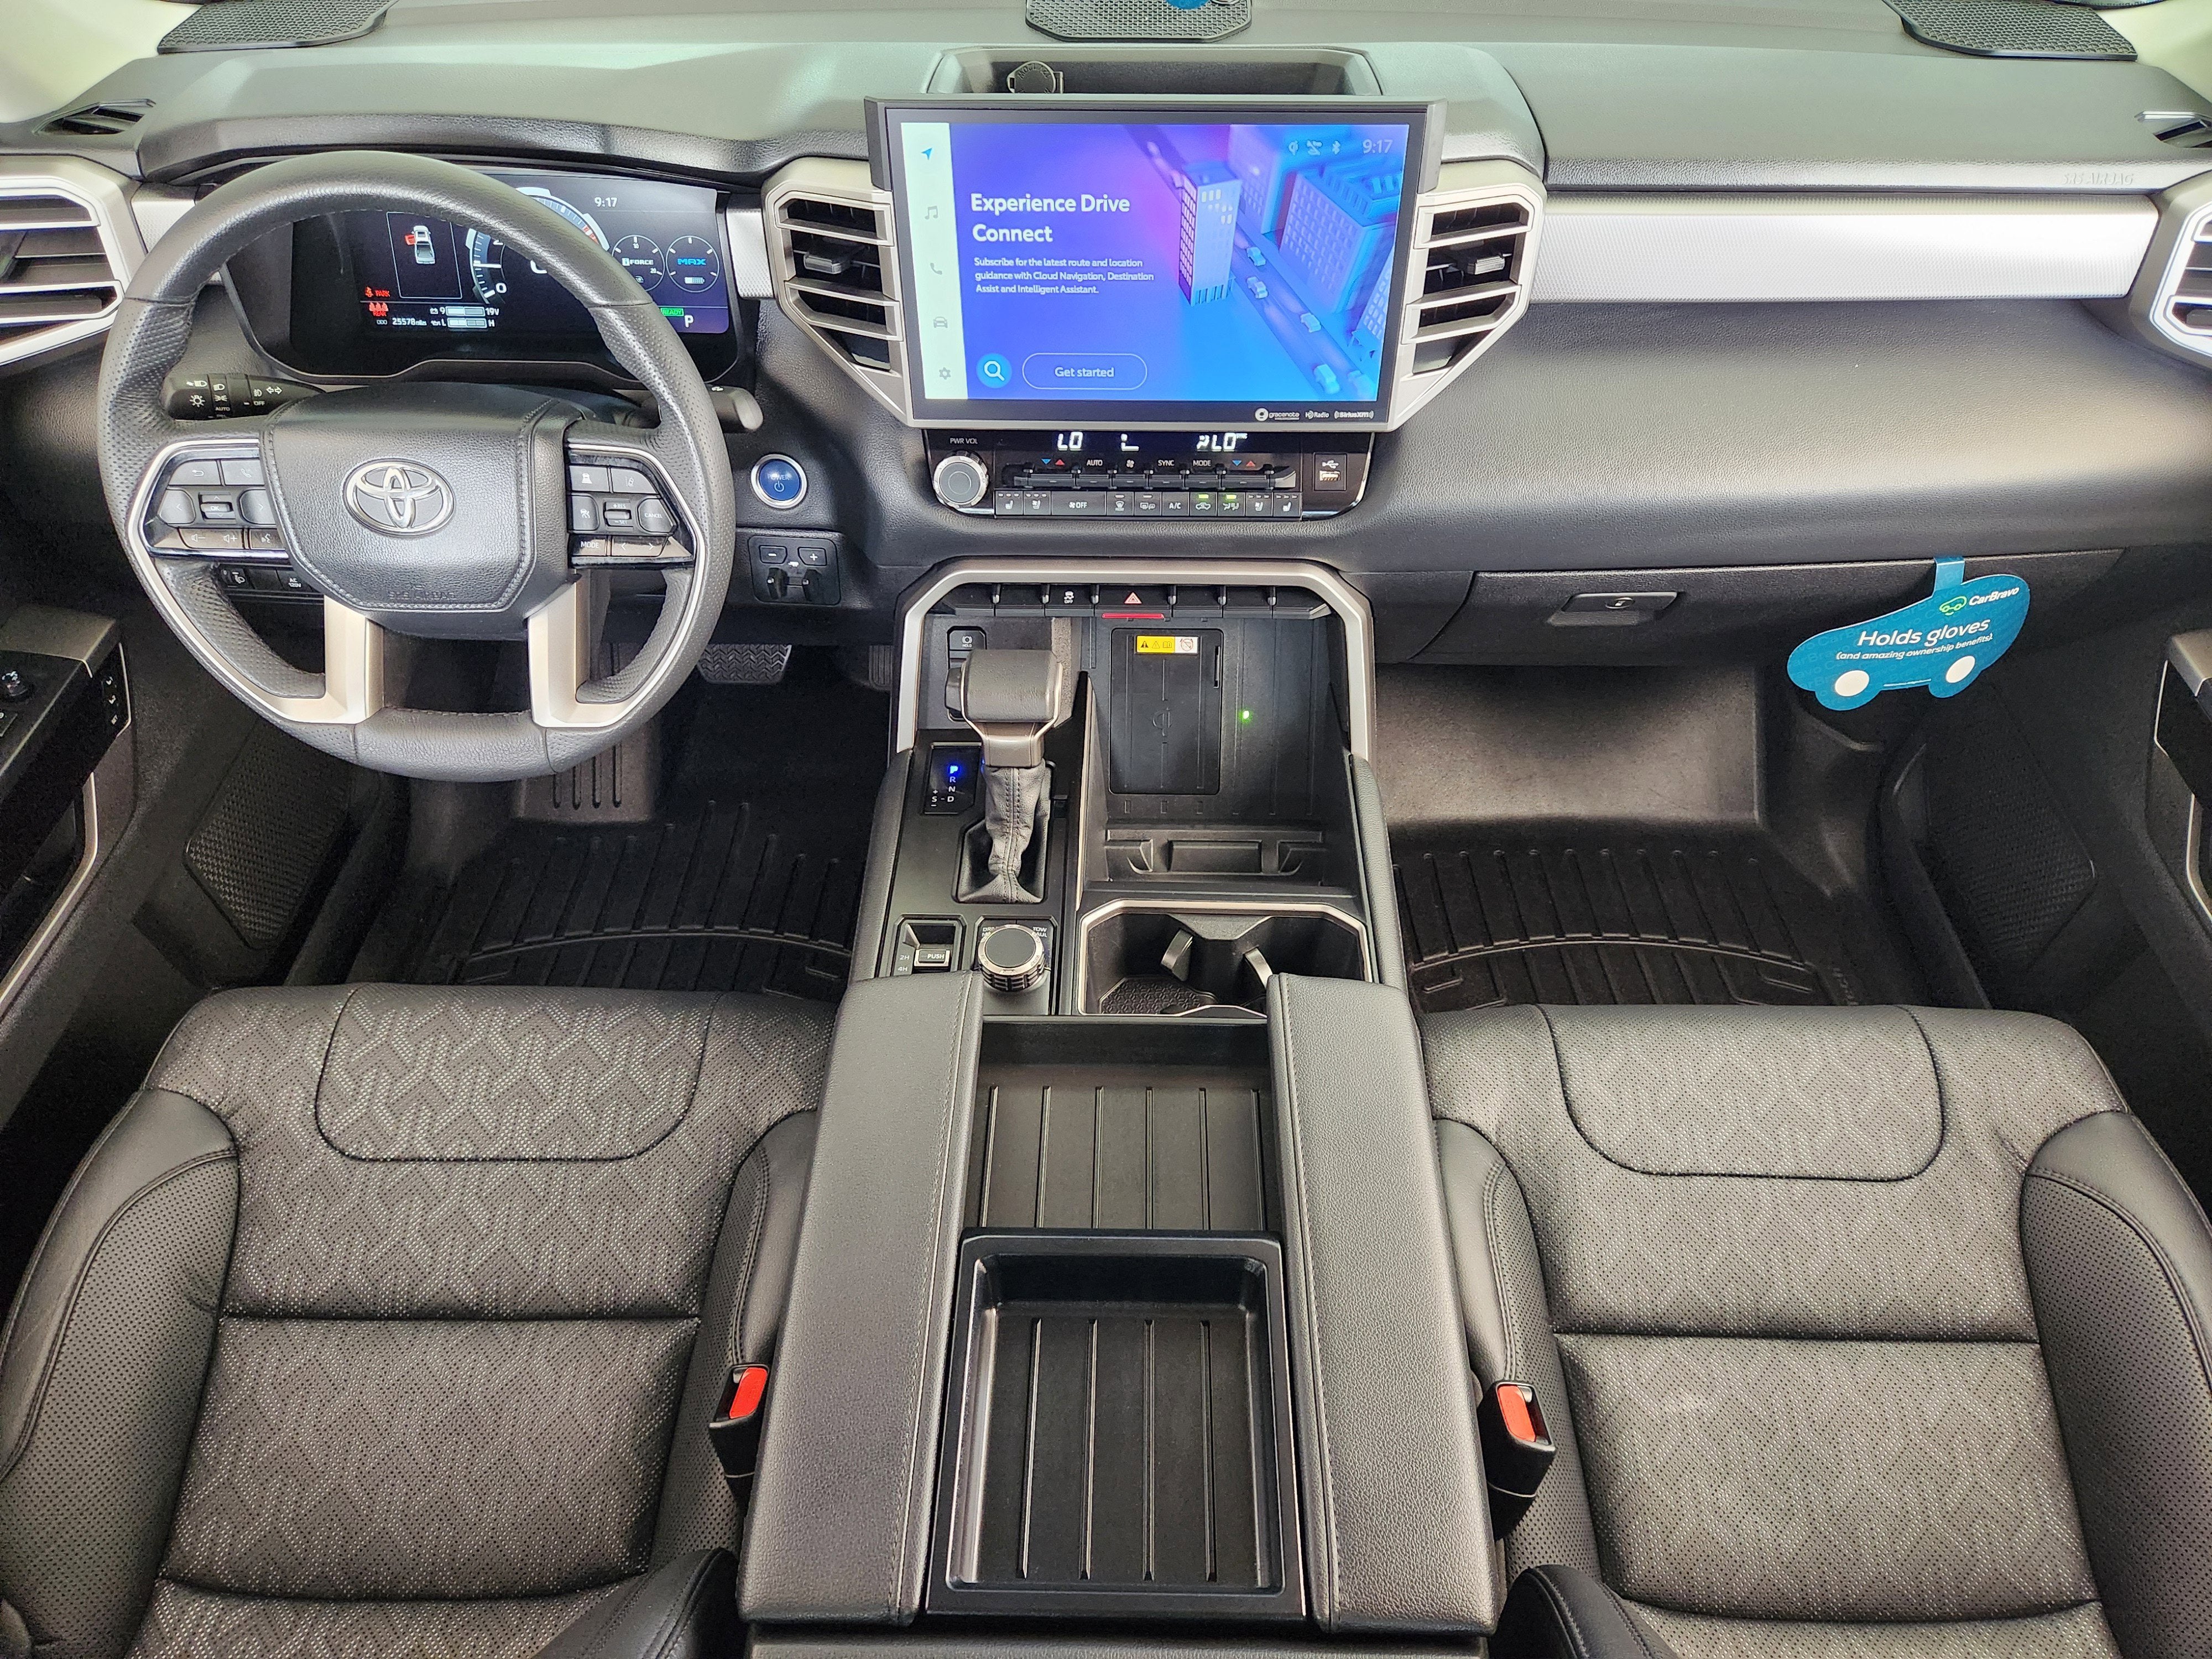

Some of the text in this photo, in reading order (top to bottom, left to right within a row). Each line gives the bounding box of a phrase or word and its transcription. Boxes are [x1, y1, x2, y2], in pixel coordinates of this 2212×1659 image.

[1363, 139, 1393, 154] 9:17
[594, 197, 618, 207] 9:17
[971, 192, 1130, 216] Experience Drive
[972, 223, 1053, 242] Connect
[974, 257, 1014, 267] Subscribe
[1015, 257, 1027, 267] for
[1028, 258, 1042, 267] the
[1043, 258, 1067, 267] latest
[1092, 258, 1108, 267] and
[1109, 258, 1143, 267] location
[974, 270, 1154, 282] guidance with Cloud Navigation, Destination
[495, 283, 507, 293] 0
[976, 284, 1099, 295] Assist and Intelligent Assistant.
[439, 306, 499, 316] 9 19V
[684, 315, 694, 327] P
[1055, 367, 1114, 377] Get started
[1969, 587, 2020, 606] CarBravo
[1856, 619, 1991, 647] Holds gloves
[1835, 651, 1860, 660] (and
[1861, 650, 1906, 660] amazing
[1906, 643, 1954, 658] ownership
[950, 765, 958, 774] P
